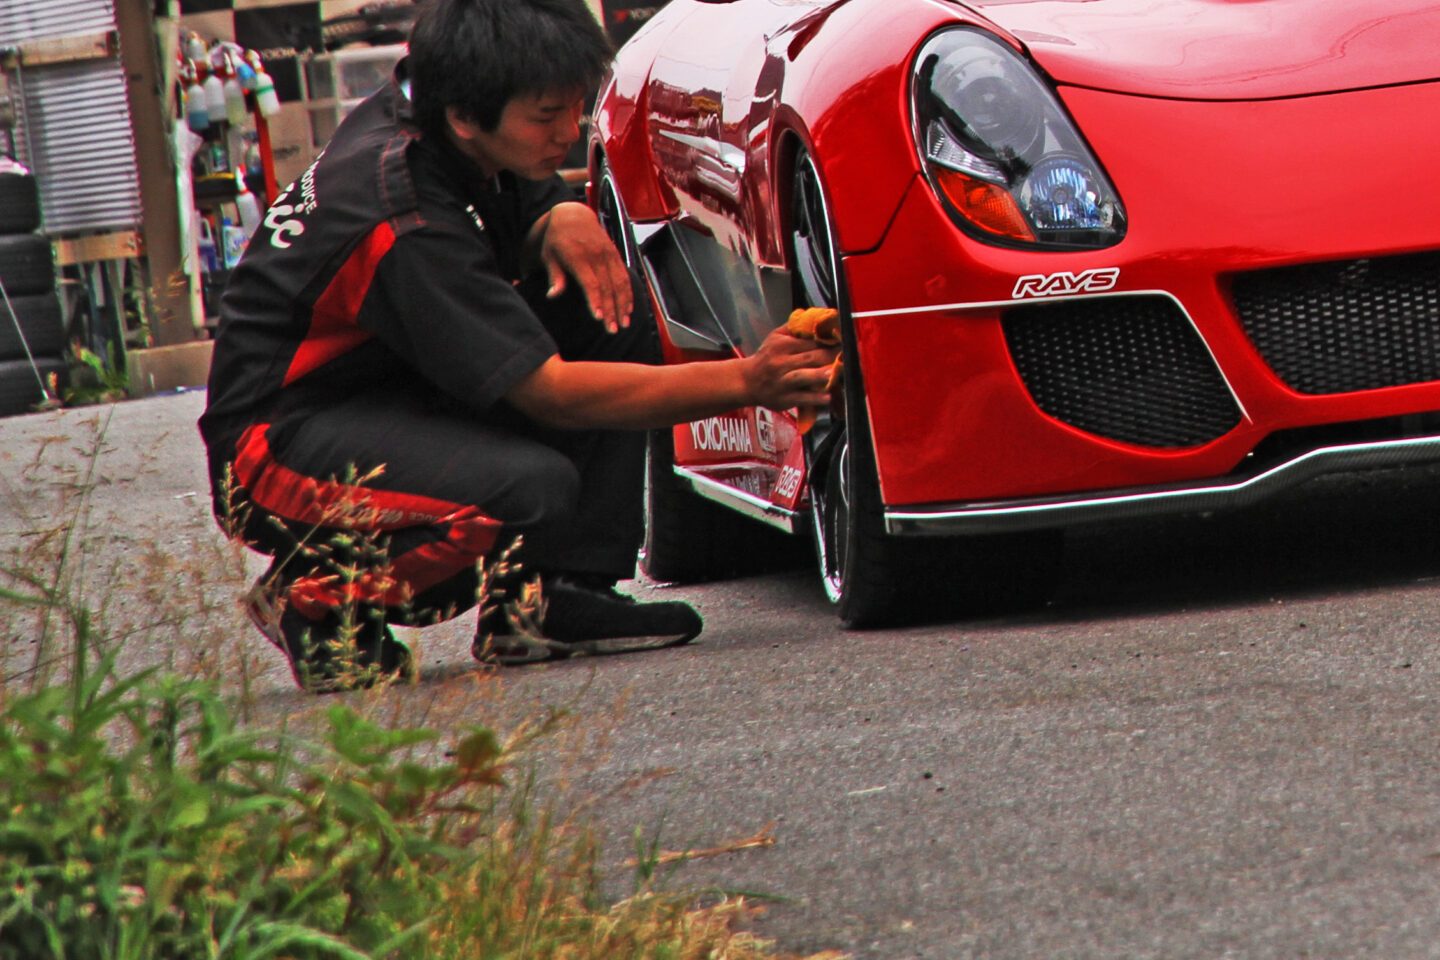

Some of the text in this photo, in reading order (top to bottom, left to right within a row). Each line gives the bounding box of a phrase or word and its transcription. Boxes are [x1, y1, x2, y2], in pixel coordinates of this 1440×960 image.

[300, 160, 320, 215] ODUCE
[1012, 267, 1120, 298] RAYS
[690, 417, 752, 453] YOKOHAMA
